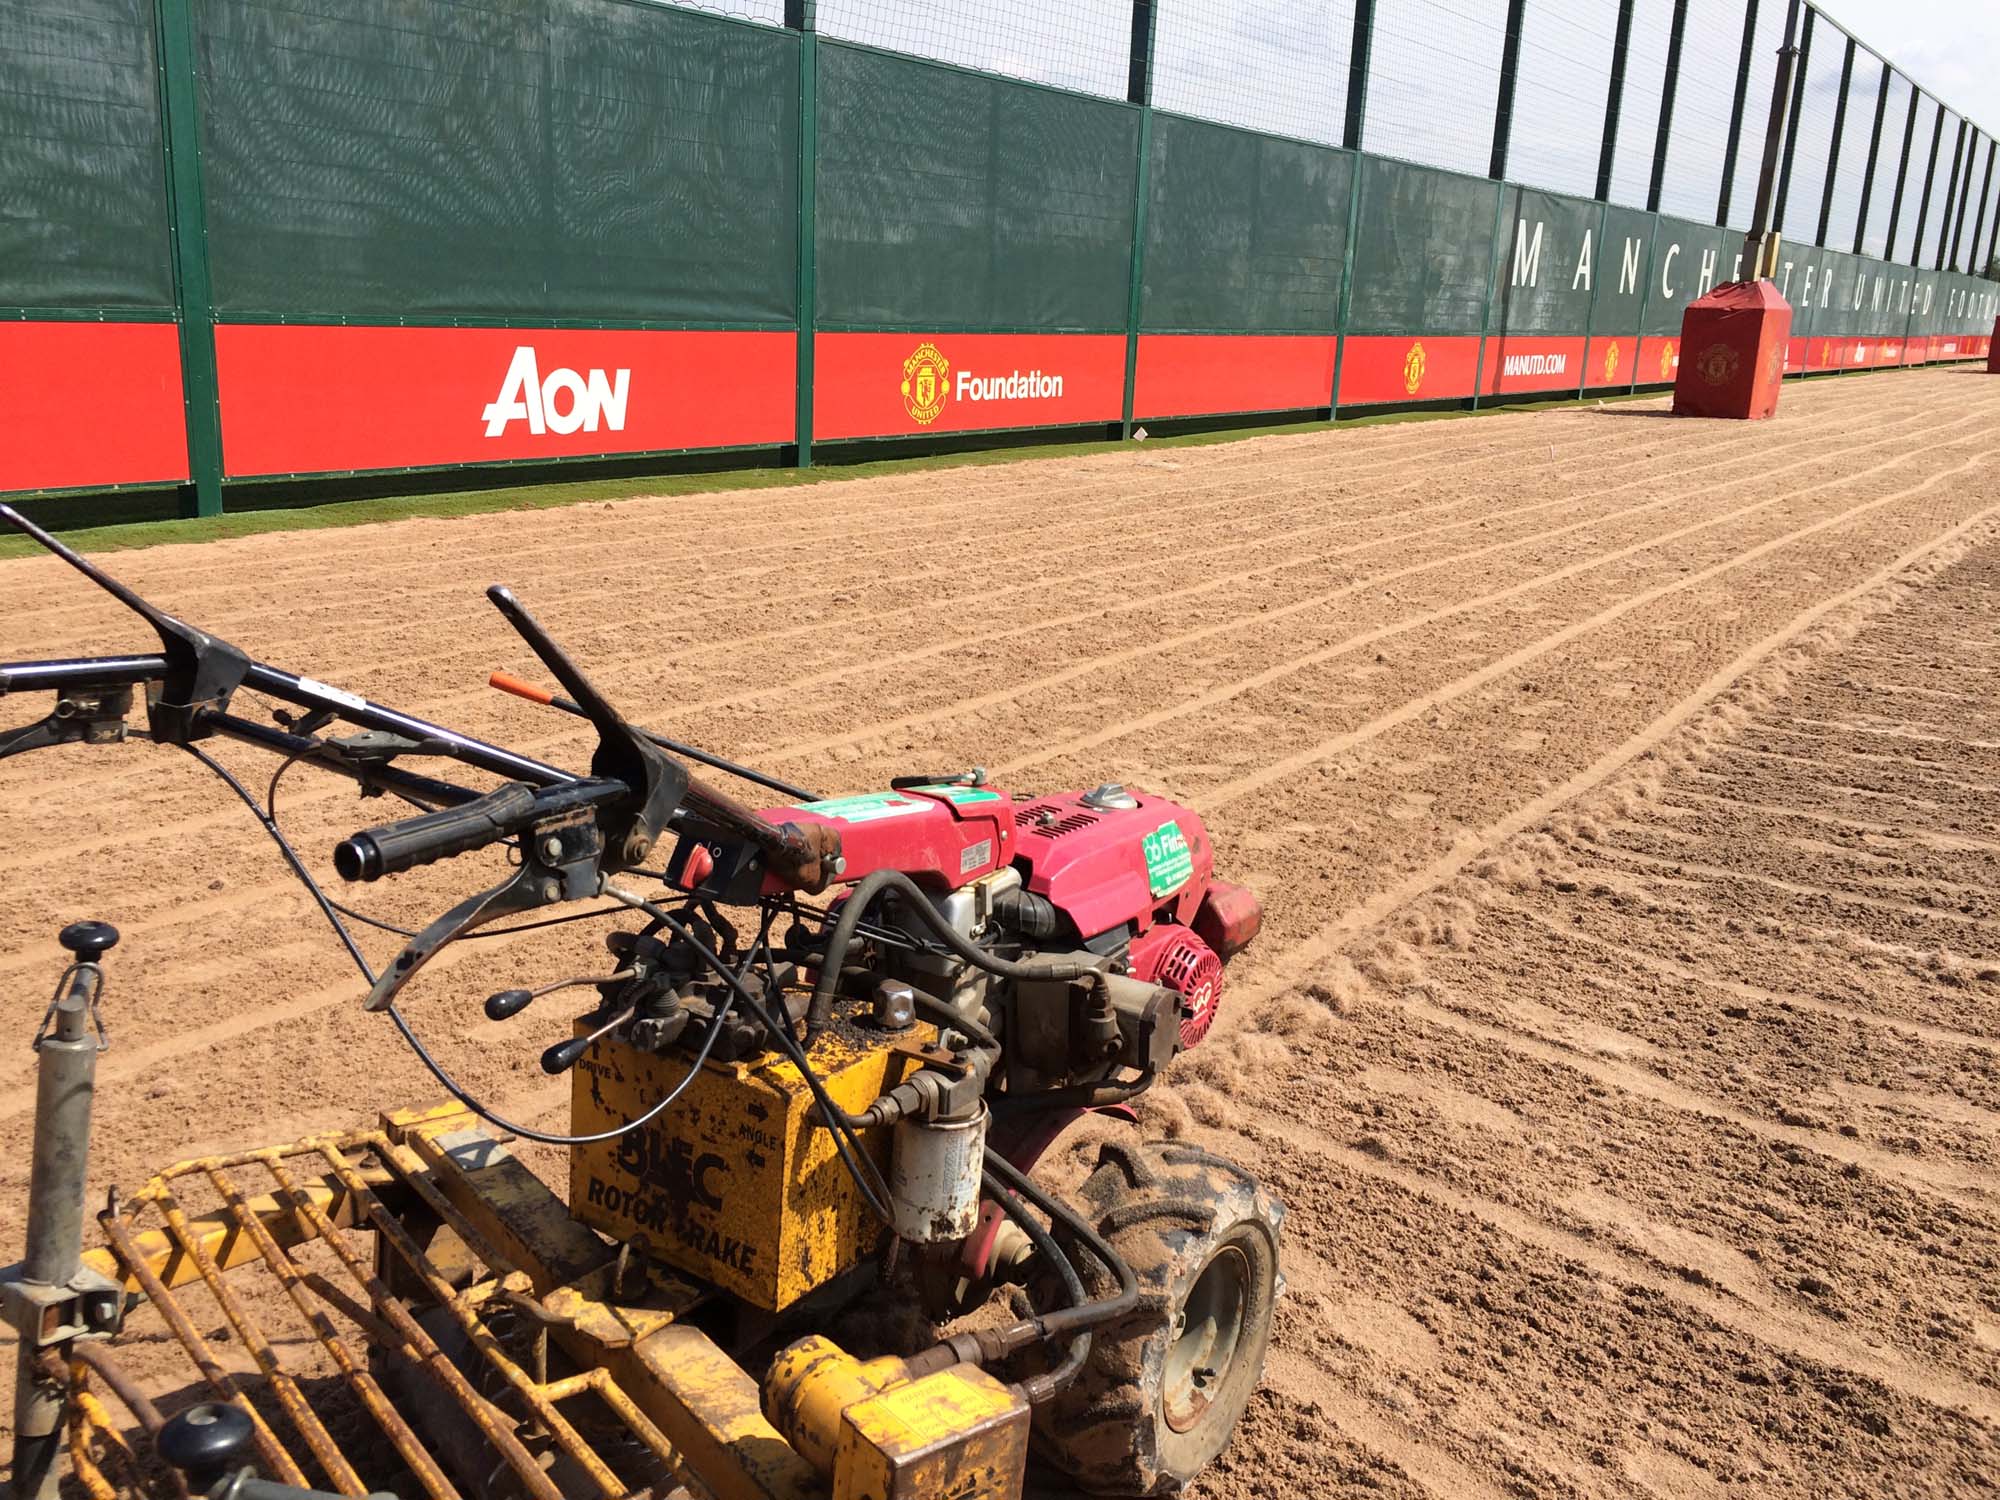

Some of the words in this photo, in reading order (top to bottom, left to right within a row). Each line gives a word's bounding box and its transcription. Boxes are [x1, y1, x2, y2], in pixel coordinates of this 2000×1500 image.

[1512, 219, 1833, 309] MANCHETER
[1854, 273, 1932, 316] UNITED
[1504, 354, 1567, 376] MANUTD.COM
[481, 346, 631, 438] AON
[956, 369, 1064, 402] Foundation
[911, 404, 940, 419] UNITED
[579, 1058, 611, 1079] DRIVE
[738, 1123, 777, 1151] ANGLE
